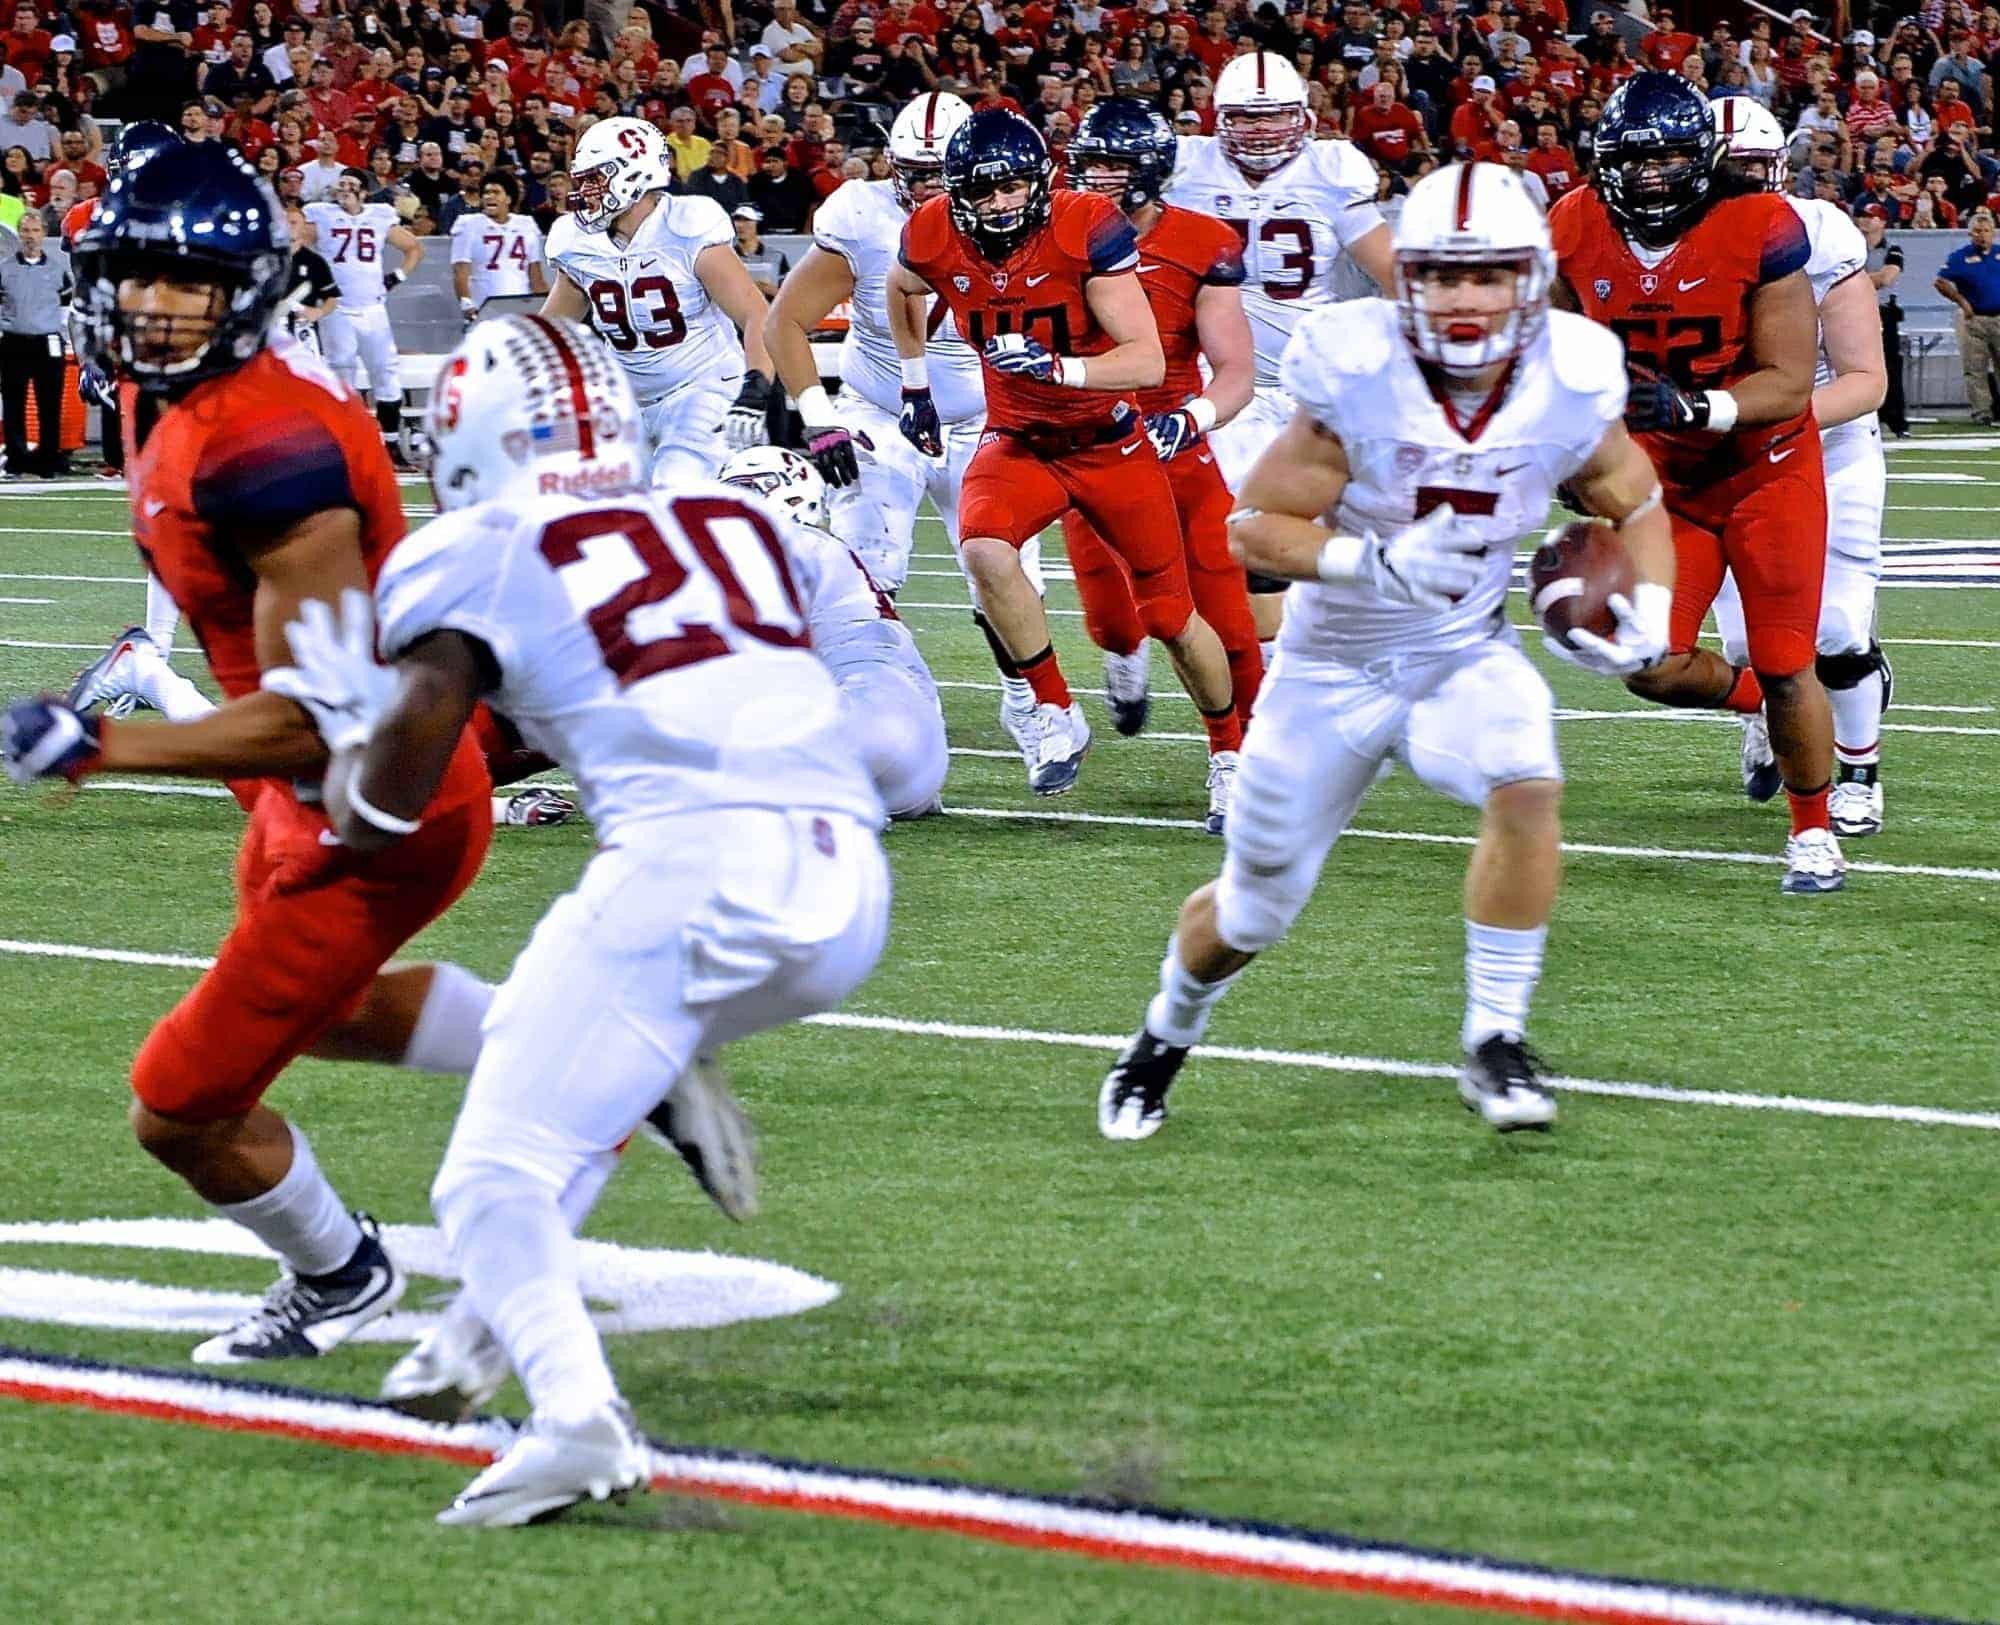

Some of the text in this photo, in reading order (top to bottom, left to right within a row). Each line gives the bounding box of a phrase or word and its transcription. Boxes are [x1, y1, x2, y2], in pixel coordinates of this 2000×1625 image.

[331, 228, 376, 263] 76
[483, 235, 527, 271] 74
[589, 275, 687, 351] 93
[538, 462, 630, 495] Riddell
[539, 496, 813, 687] 20
